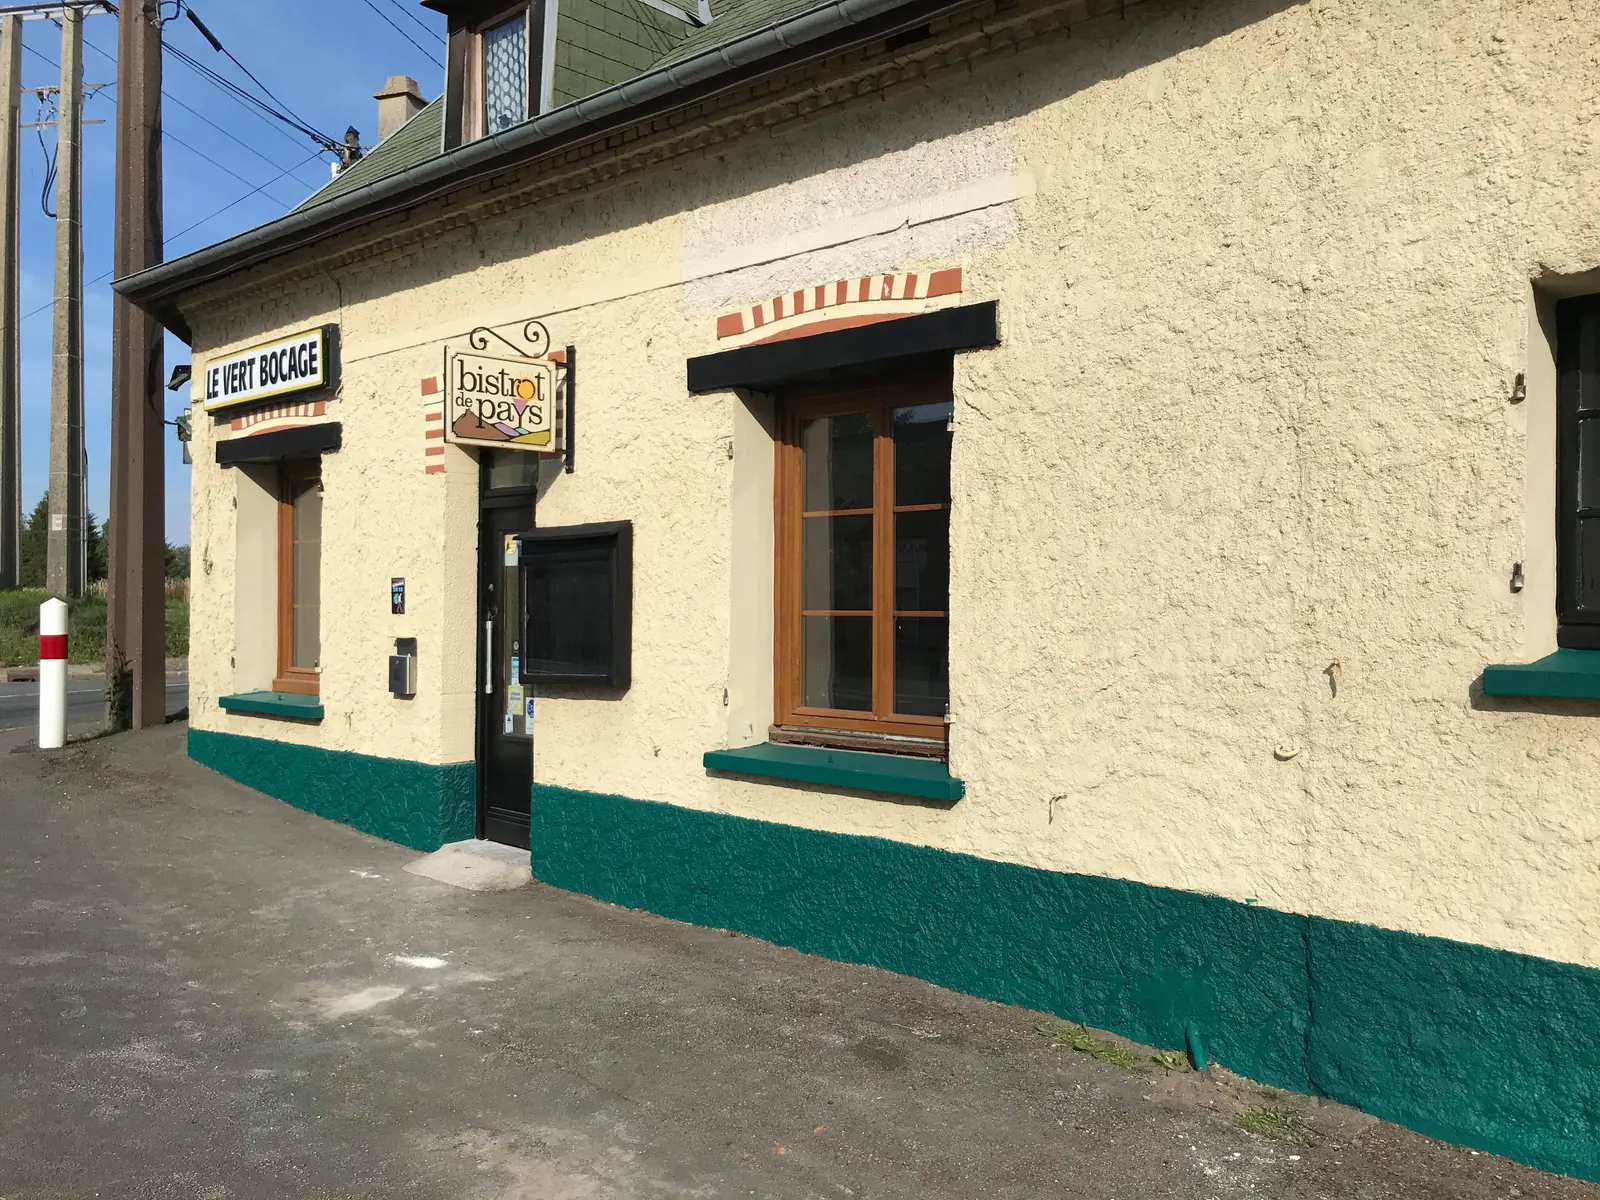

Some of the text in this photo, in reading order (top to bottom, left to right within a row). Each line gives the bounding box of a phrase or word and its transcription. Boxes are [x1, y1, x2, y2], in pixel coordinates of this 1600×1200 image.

[206, 340, 318, 400] LE VERT BOCAGE
[457, 359, 545, 402] bistrot
[455, 391, 543, 429] de pays
